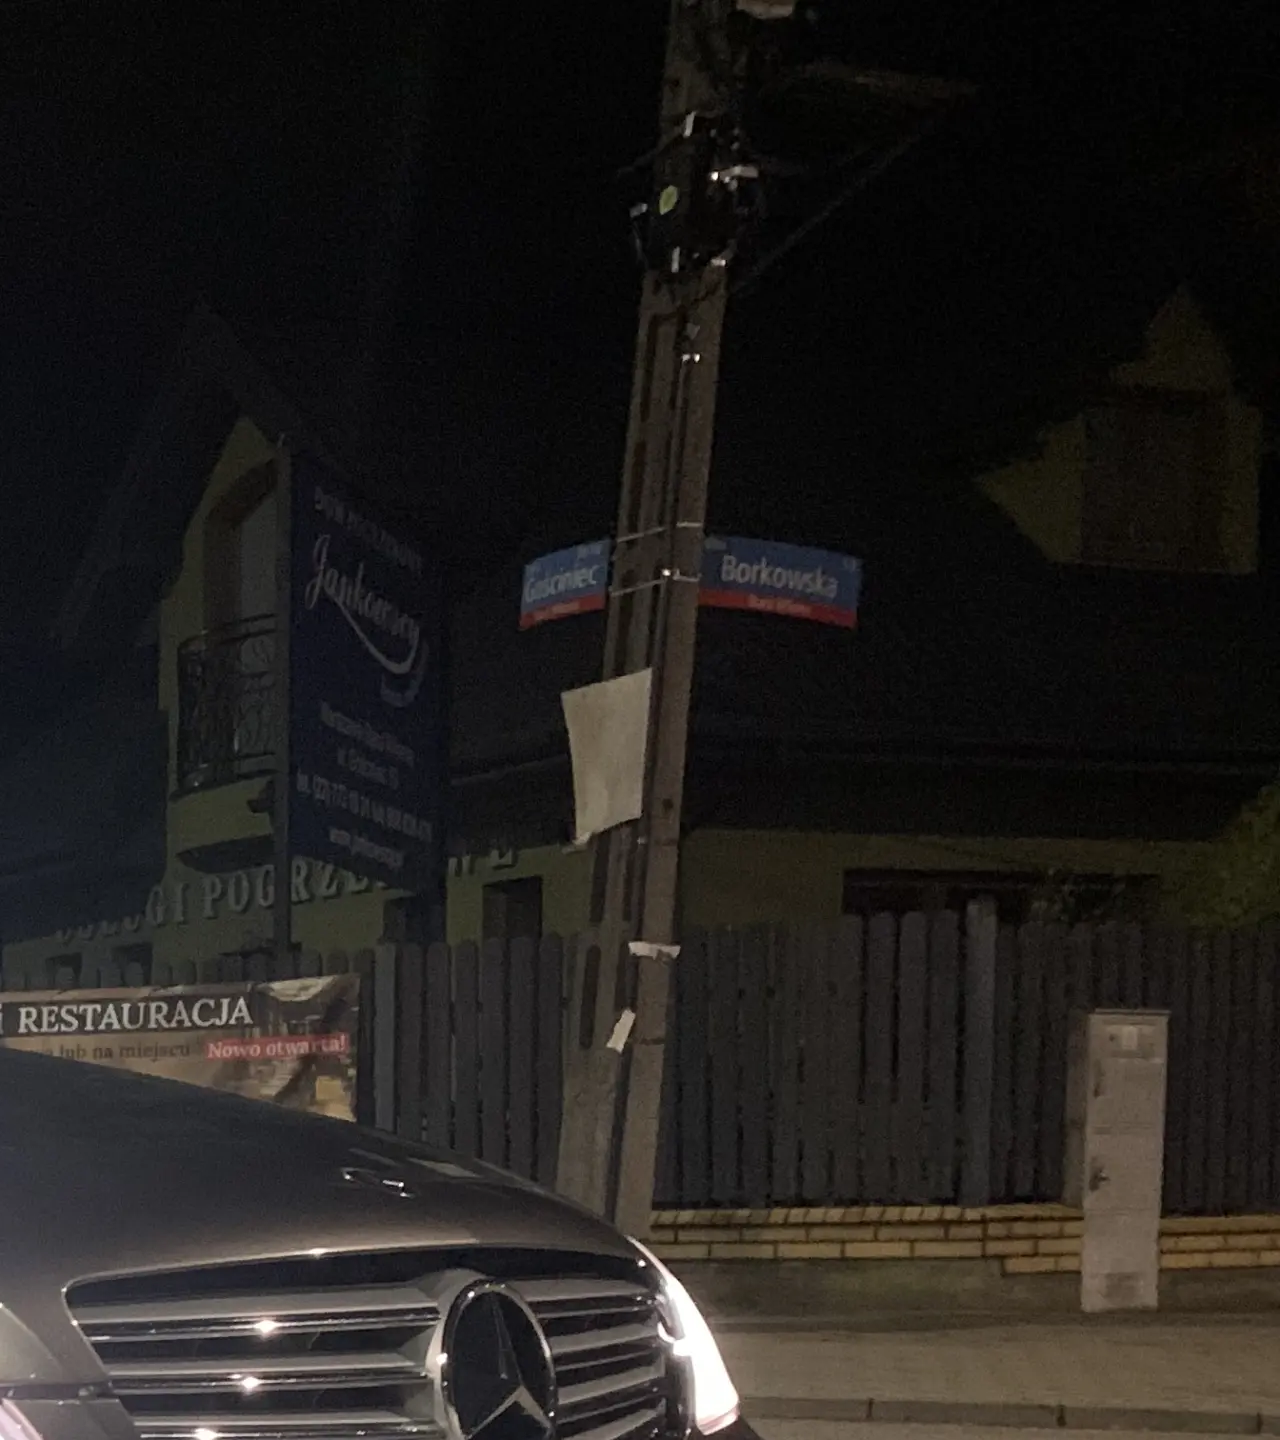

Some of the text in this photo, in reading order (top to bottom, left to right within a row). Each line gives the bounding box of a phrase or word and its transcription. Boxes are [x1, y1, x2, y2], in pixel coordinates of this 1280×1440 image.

[720, 554, 839, 600] Borkowska
[17, 996, 254, 1034] RESTAURACJA
[92, 1047, 113, 1060] na
[119, 1043, 190, 1063] miejscu
[207, 1035, 347, 1059] Nowo otwarta!
